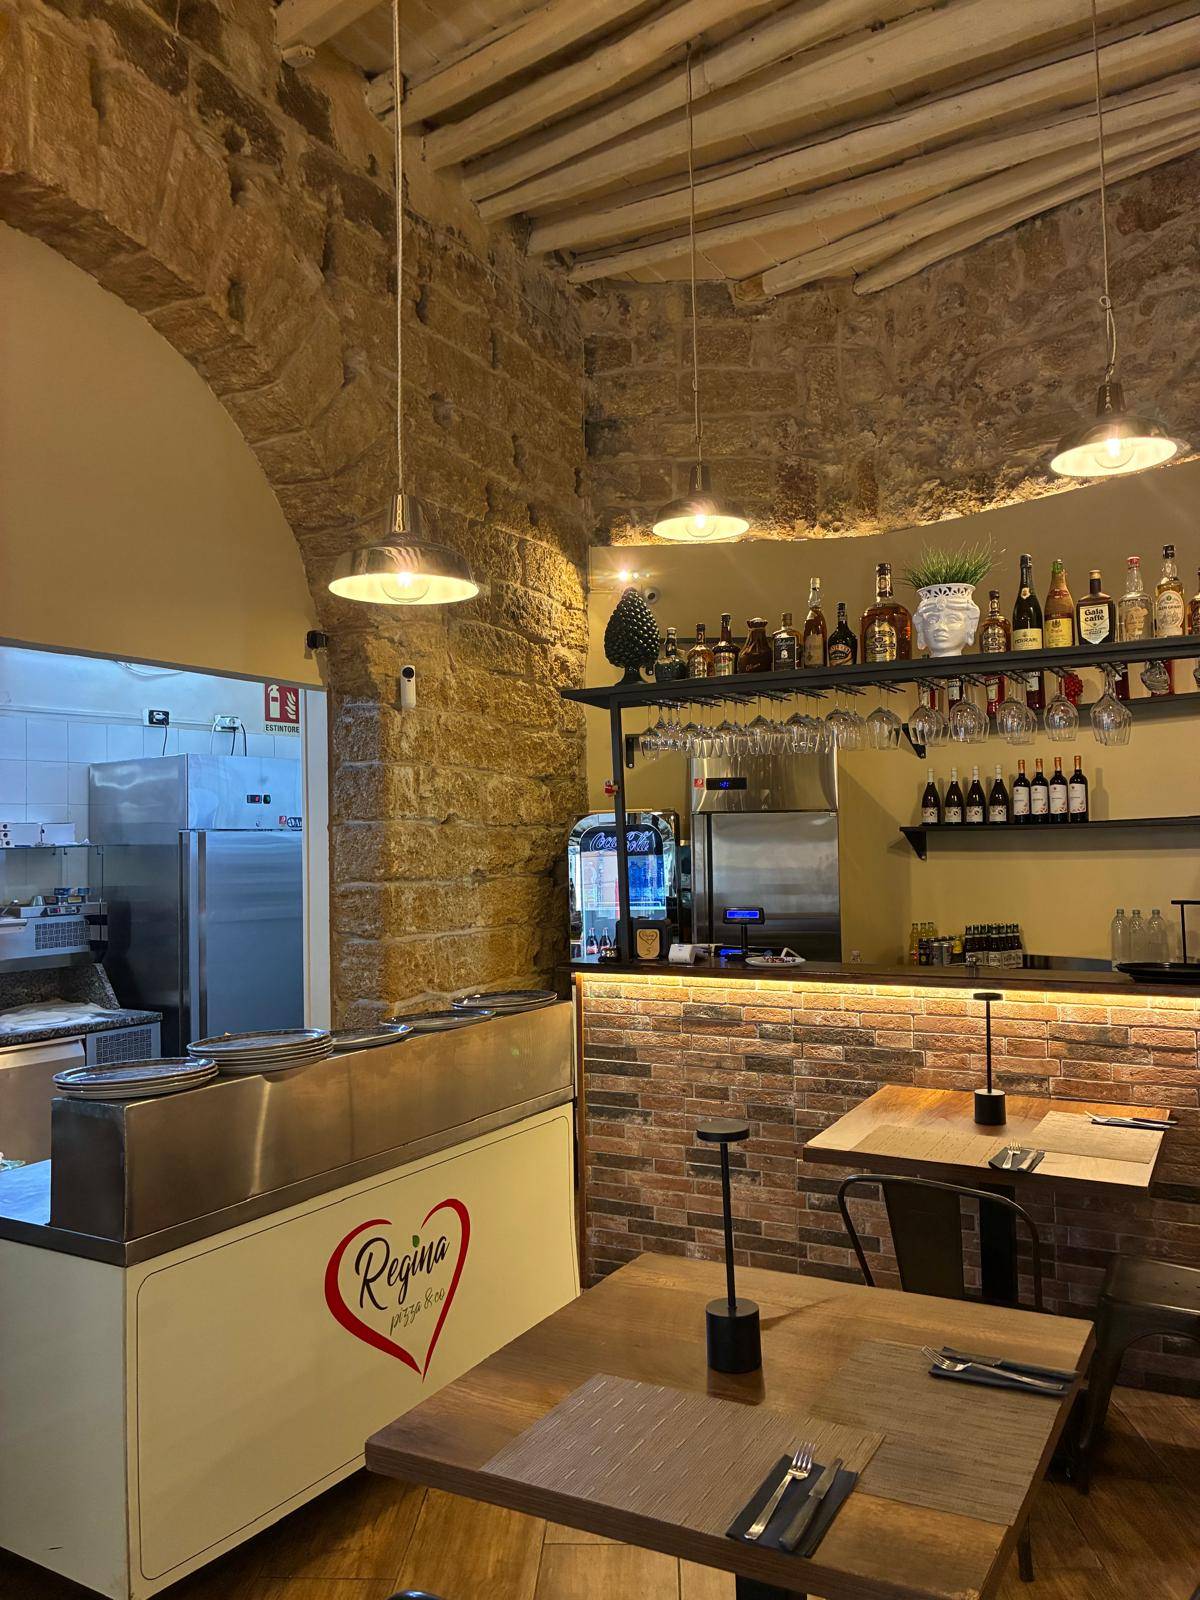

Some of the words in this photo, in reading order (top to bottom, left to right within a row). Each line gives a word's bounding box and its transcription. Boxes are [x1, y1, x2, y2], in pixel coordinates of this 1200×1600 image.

[265, 724, 300, 733] ESTINTORE
[354, 1235, 450, 1310] Regina
[389, 1300, 423, 1336] pizza
[424, 1286, 433, 1309] &
